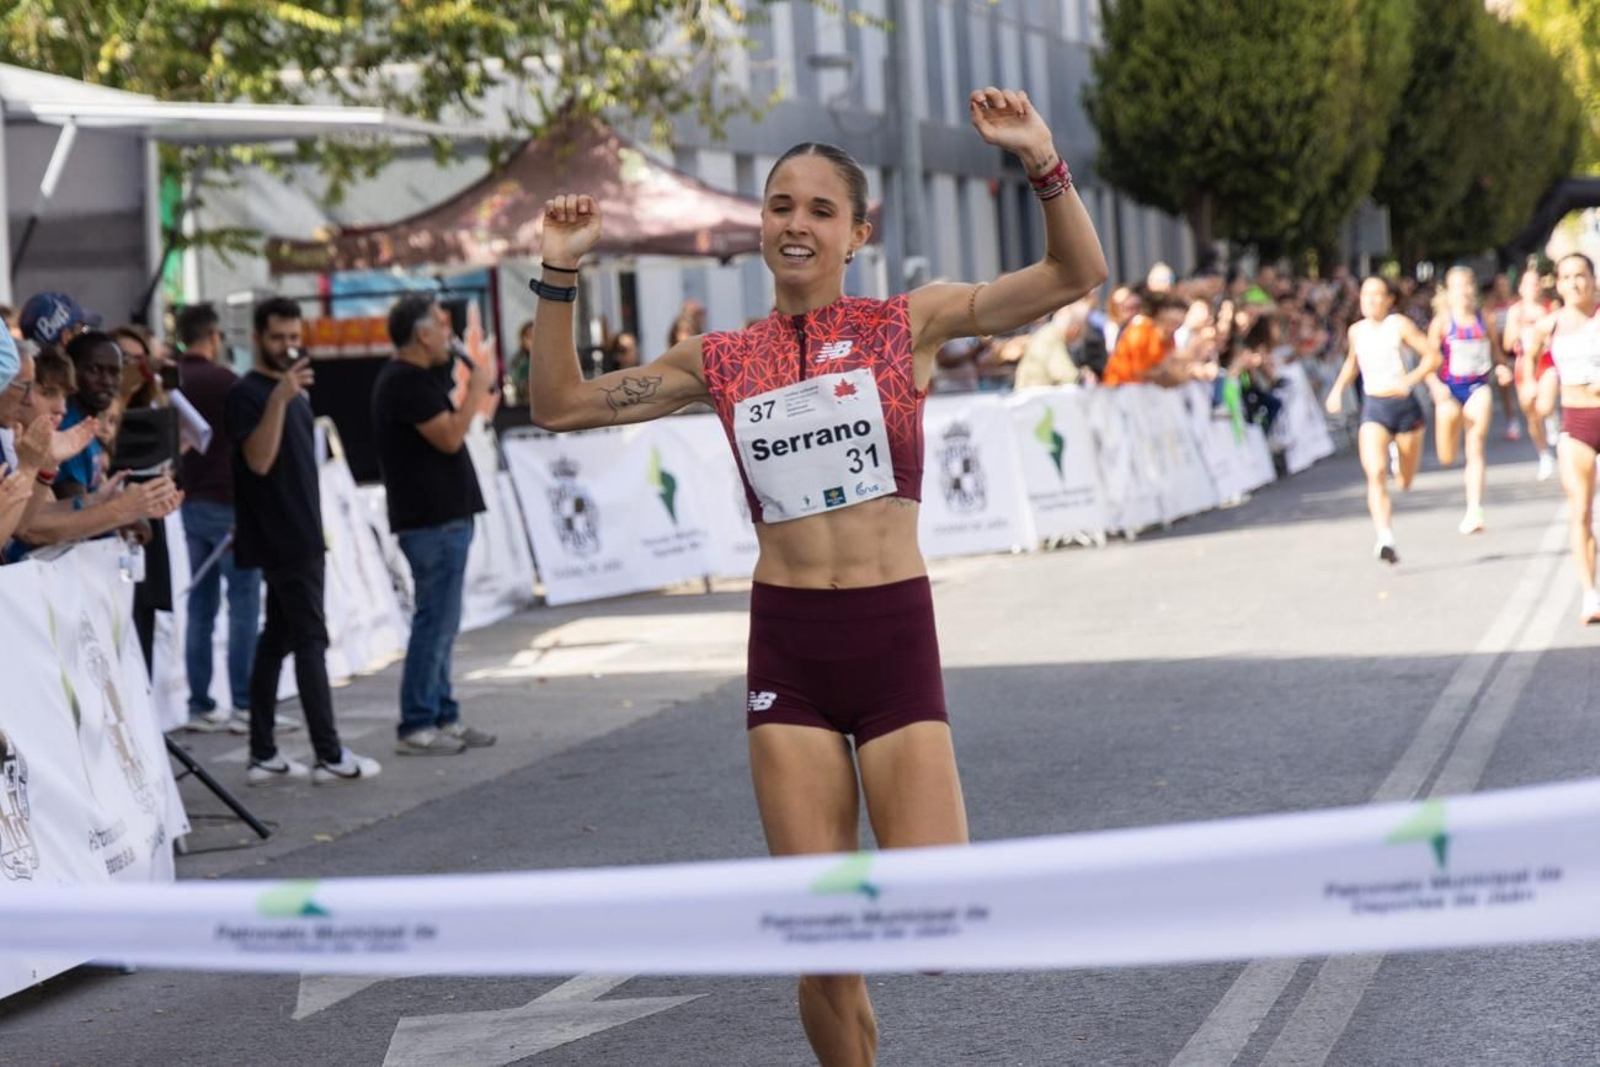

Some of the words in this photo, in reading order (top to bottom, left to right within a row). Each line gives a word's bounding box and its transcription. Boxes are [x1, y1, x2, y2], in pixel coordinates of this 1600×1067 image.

[749, 400, 776, 423] 37
[751, 419, 871, 461] Serrano
[846, 443, 880, 474] 31
